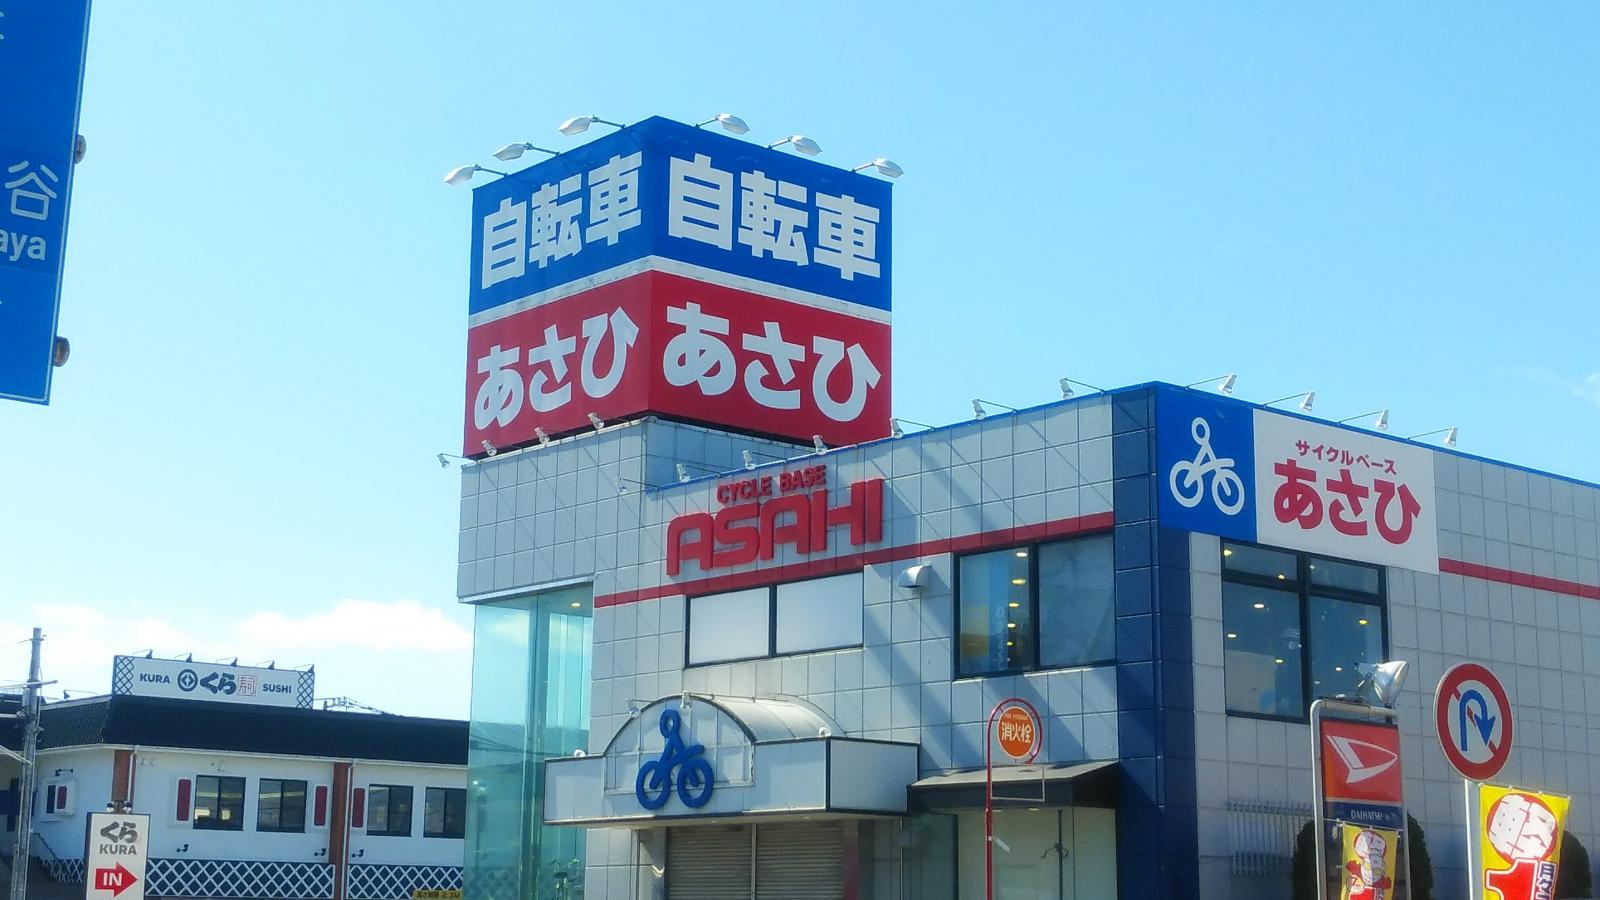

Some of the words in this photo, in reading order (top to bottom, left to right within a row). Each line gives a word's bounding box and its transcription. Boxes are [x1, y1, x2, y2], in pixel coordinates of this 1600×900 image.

[5, 160, 59, 221] 谷
[481, 151, 643, 290] 自転車
[668, 153, 881, 281] 自転車
[474, 306, 640, 430] あさひ
[663, 301, 882, 422] あさひ
[1295, 439, 1397, 475] サイクルベース
[716, 476, 773, 504] CYCLE
[779, 464, 827, 492] BASE
[1273, 458, 1422, 545] あさひ
[666, 478, 884, 577] ASAHI
[139, 672, 170, 685] KURA
[262, 682, 292, 694] SUSHI
[1001, 720, 1032, 744] 消火栓
[100, 821, 139, 843] くら
[1350, 809, 1384, 821] DAIHATSU
[99, 844, 137, 856] KURA
[102, 872, 123, 887] IN
